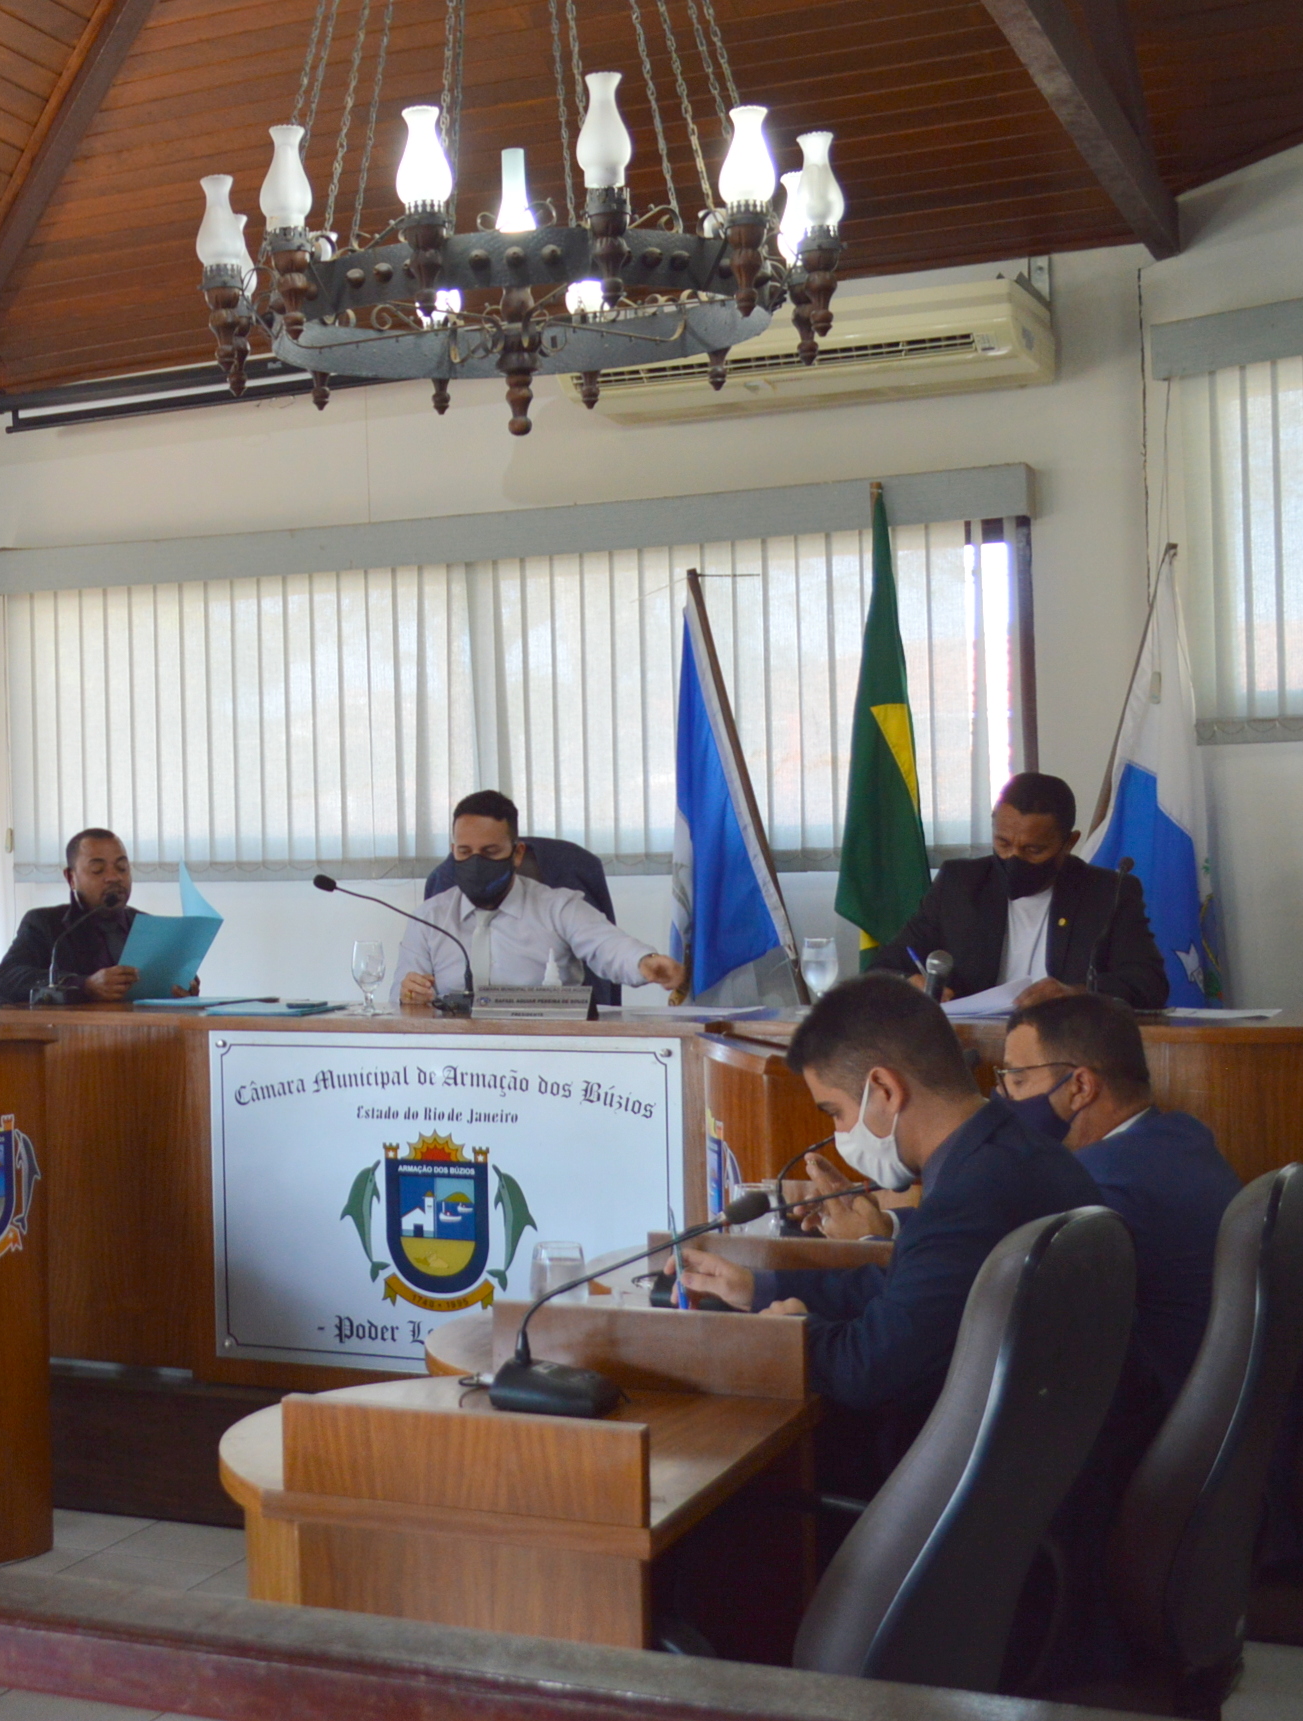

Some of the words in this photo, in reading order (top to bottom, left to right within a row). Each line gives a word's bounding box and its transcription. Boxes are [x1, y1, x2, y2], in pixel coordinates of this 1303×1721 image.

[234, 1078, 307, 1106] Câmara
[312, 1066, 410, 1094] Municipal
[416, 1066, 436, 1086] de
[442, 1065, 529, 1097] Armação
[538, 1075, 573, 1098] dos
[580, 1080, 656, 1119] Búzios
[356, 1105, 399, 1120] Estado
[403, 1106, 419, 1121] do
[424, 1107, 445, 1122] Rio
[447, 1107, 463, 1122] de
[467, 1108, 519, 1124] Janeiro
[398, 1164, 432, 1174] ARMAÇÃO
[434, 1165, 448, 1174] DOS
[450, 1165, 475, 1175] BÚZIOS
[334, 1315, 399, 1344] Poder
